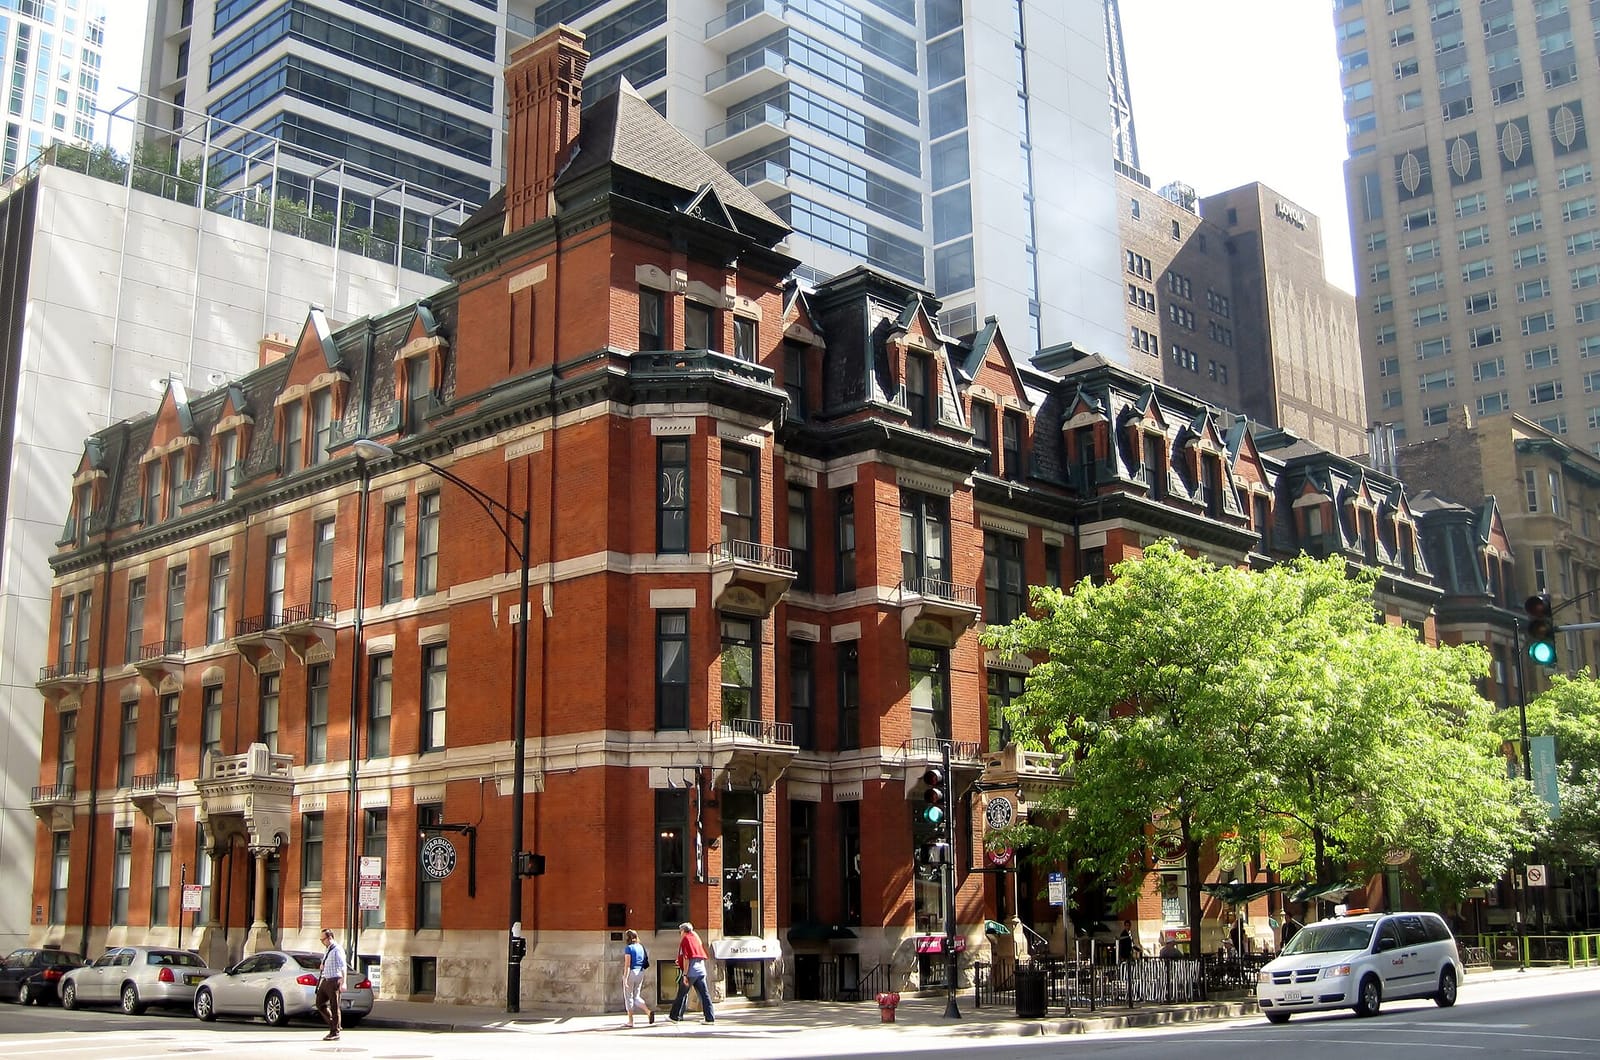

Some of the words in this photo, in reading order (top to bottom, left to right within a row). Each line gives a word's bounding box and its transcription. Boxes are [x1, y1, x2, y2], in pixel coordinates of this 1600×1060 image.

[1278, 199, 1308, 228] LOYOLA
[987, 798, 1010, 812] STARBUCKS
[424, 837, 455, 857] STARBUCKS
[426, 865, 451, 878] COFFEE
